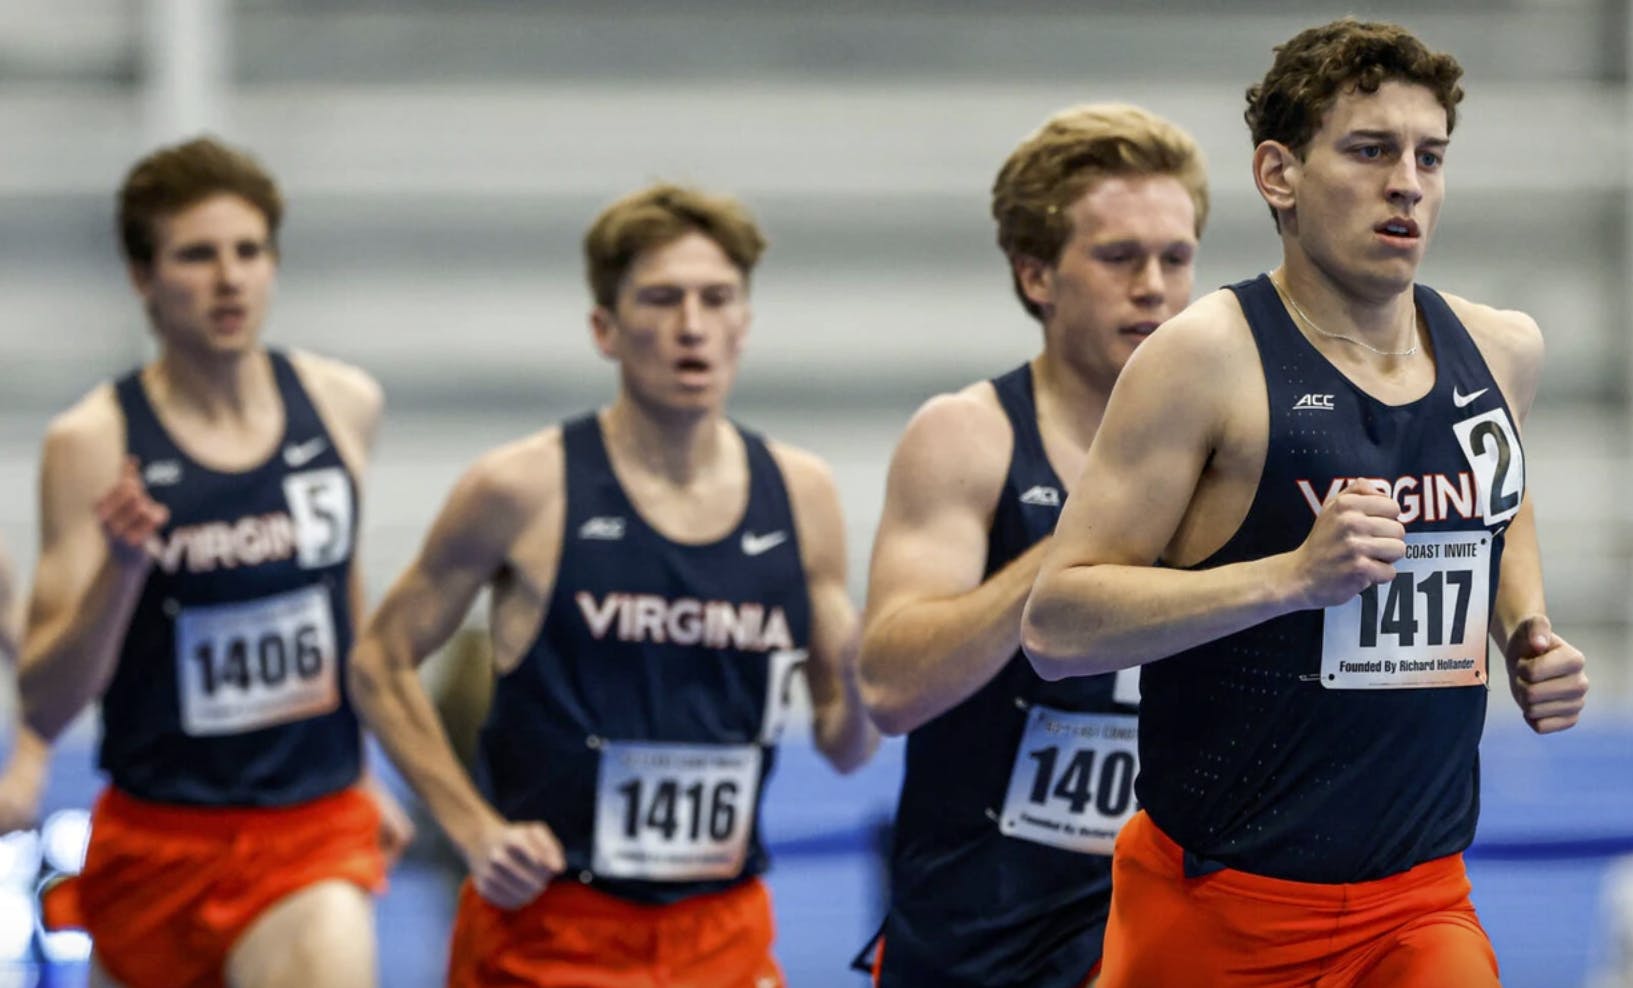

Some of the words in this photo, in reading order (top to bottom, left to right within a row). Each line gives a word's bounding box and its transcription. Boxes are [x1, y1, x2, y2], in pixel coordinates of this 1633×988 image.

[1293, 393, 1335, 409] ACC
[1469, 420, 1519, 516] 2
[310, 484, 341, 561] 5
[1405, 544, 1441, 560] COAST
[1444, 542, 1478, 558] INVITE
[576, 593, 793, 652] VIRGINIA
[1358, 569, 1474, 649] 1417
[194, 625, 323, 696] 1406
[1339, 660, 1382, 674] Founded
[1384, 660, 1397, 674] By
[1399, 658, 1436, 673] Richard
[1437, 657, 1475, 672] Hollander
[617, 779, 738, 842] 1416
[1029, 745, 1137, 818] 140
